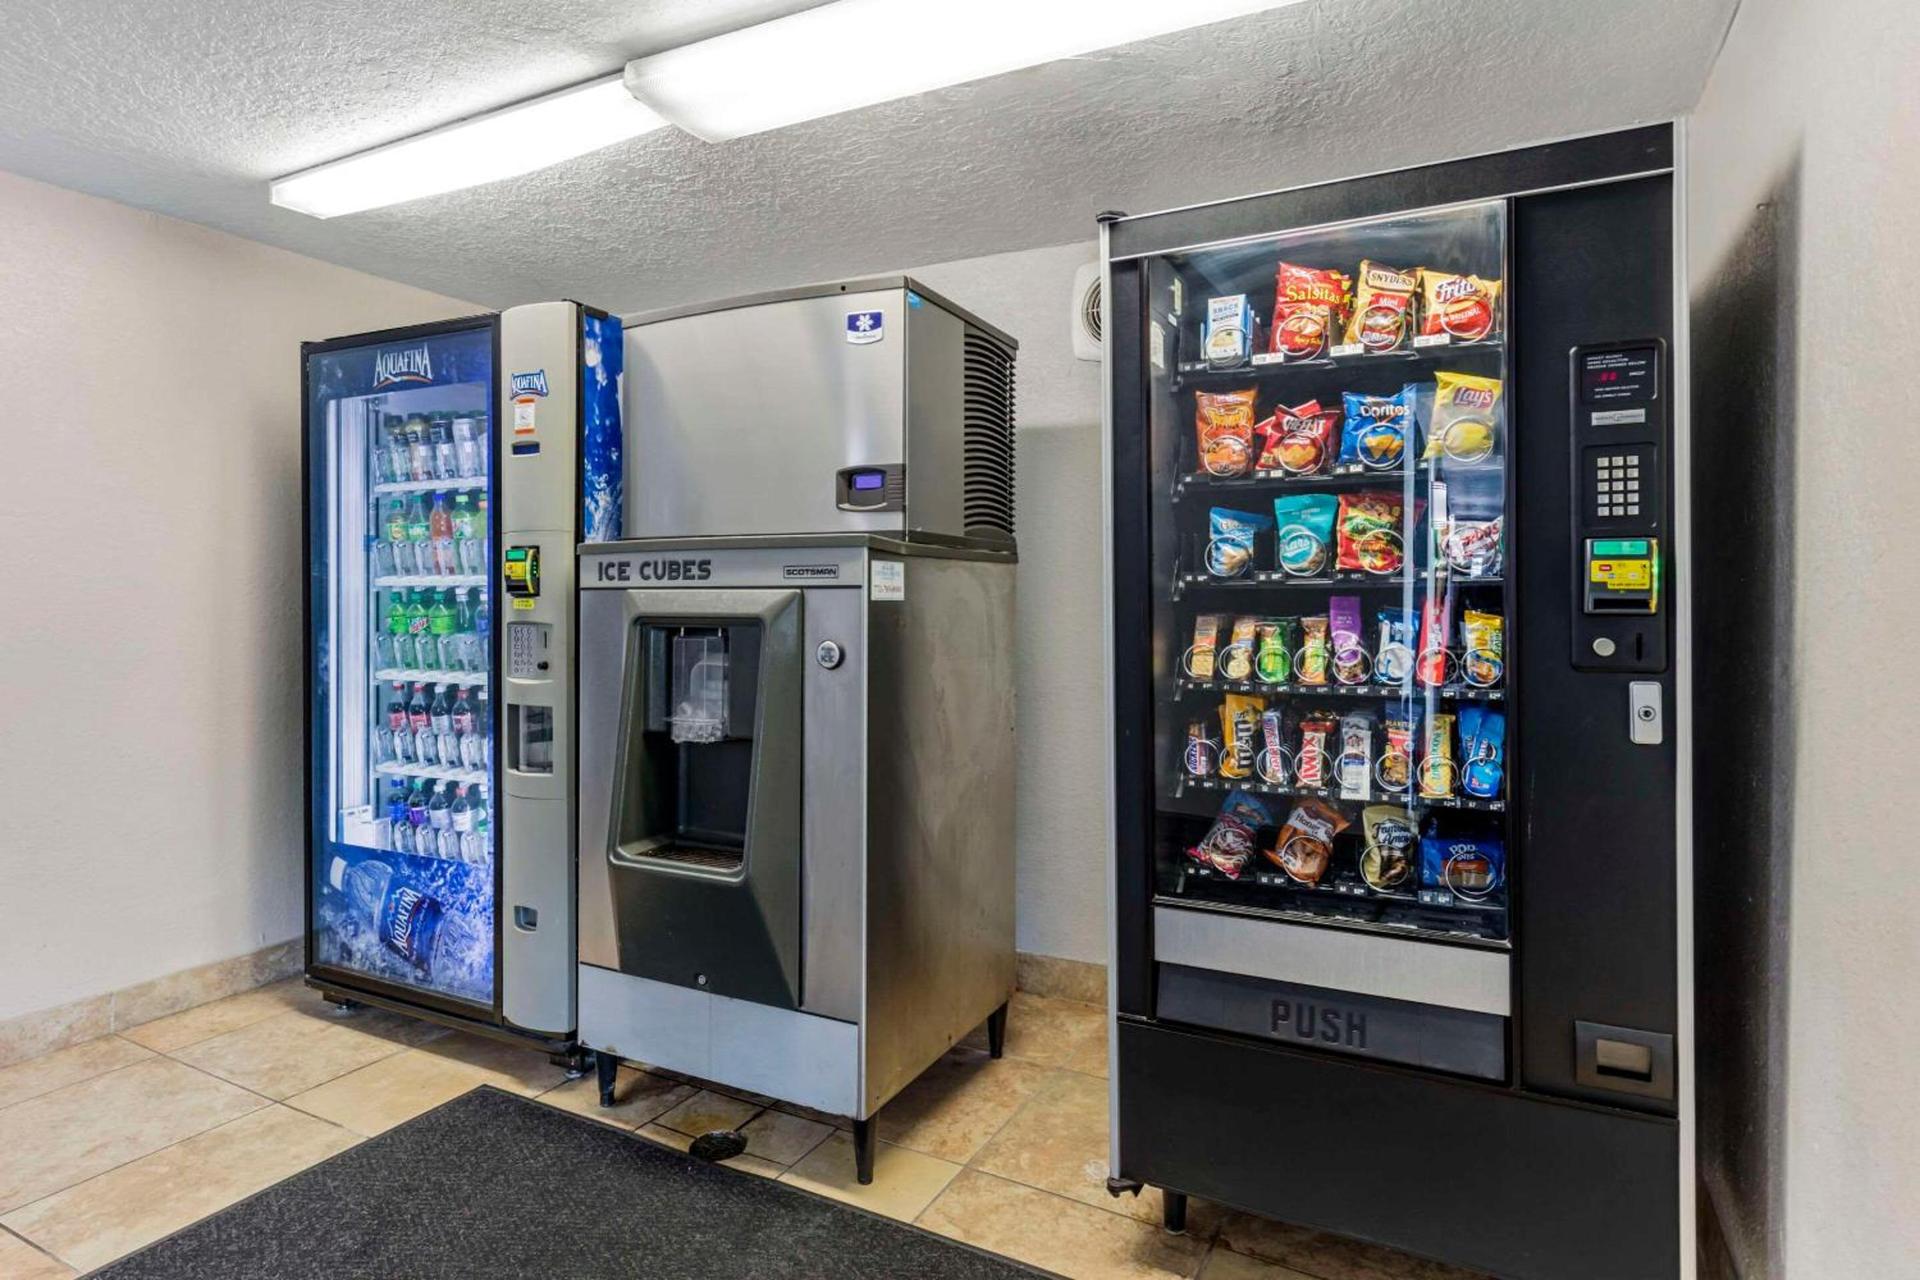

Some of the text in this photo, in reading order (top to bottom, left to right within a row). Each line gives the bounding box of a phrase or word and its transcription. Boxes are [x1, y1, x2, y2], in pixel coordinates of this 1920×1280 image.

[1286, 284, 1341, 304] Salsitas
[373, 343, 433, 388] AQUAFINA
[512, 370, 548, 395] AQUAFINA
[1360, 404, 1410, 417] Doritos
[598, 559, 712, 581] ICE CUBES
[785, 568, 838, 576] SCOTSMAN
[1270, 999, 1367, 1051] PUSH
